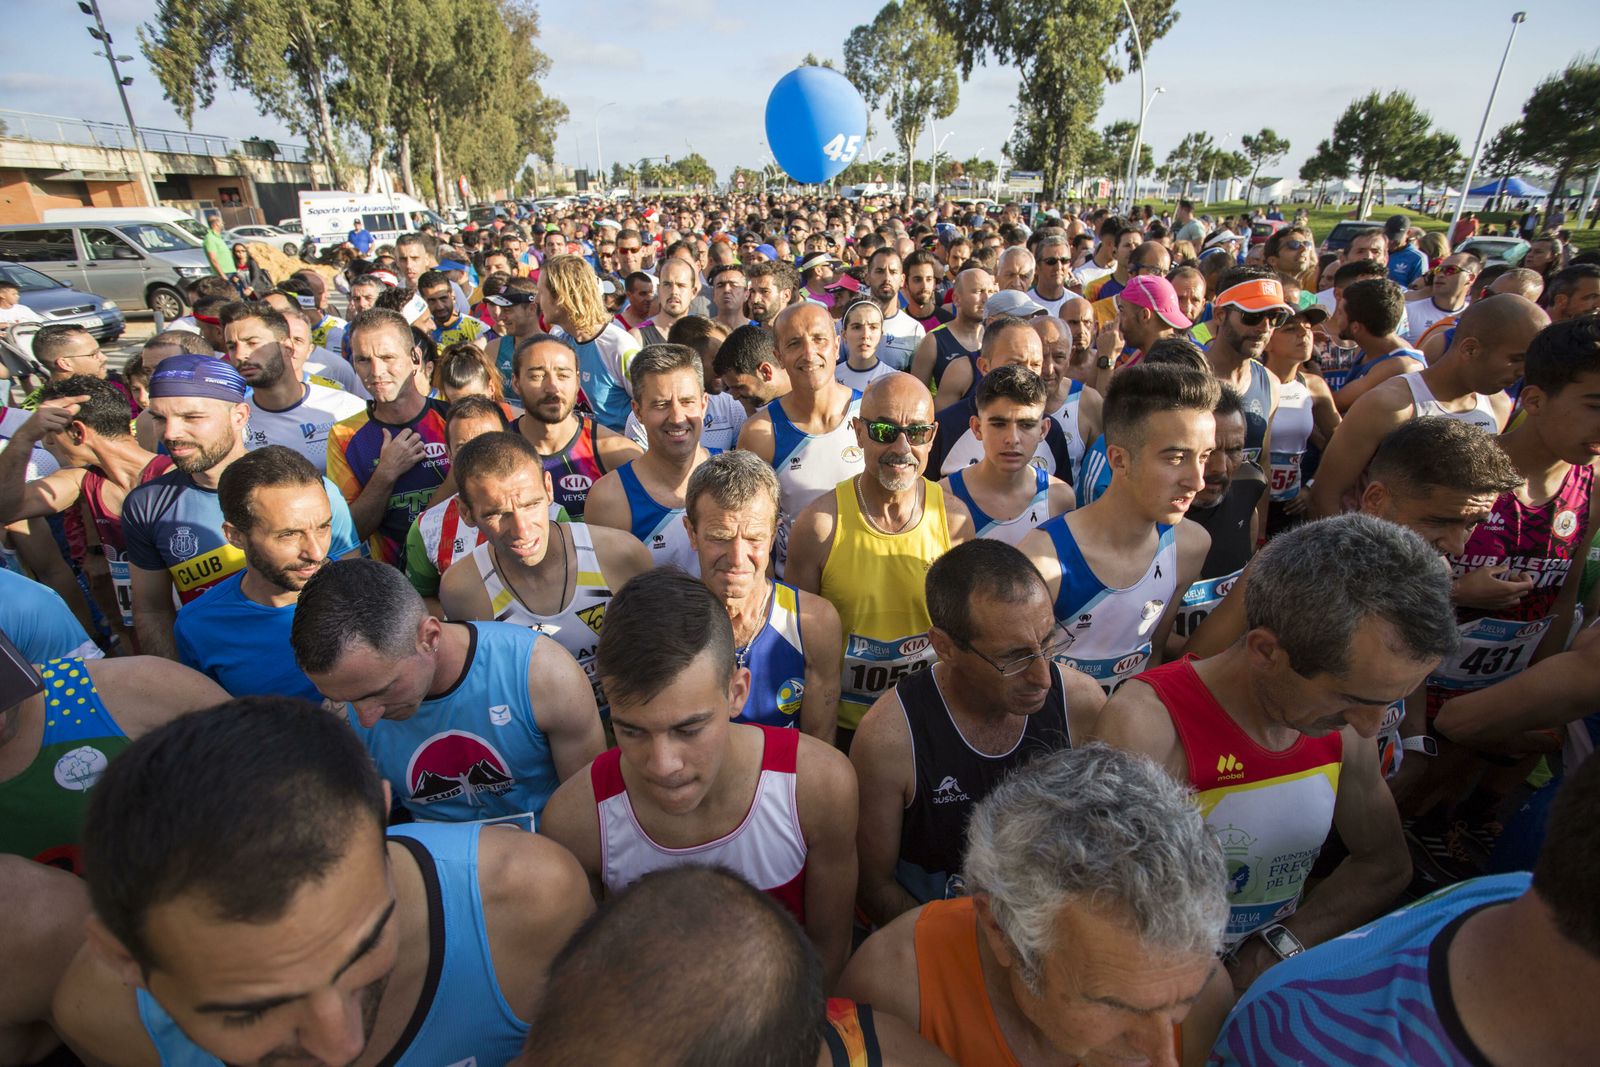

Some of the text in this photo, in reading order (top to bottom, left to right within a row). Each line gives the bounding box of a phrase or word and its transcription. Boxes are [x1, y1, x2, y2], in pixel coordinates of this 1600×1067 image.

[823, 133, 861, 162] 45
[307, 207, 340, 216] Soporte
[565, 478, 588, 488] KIA
[177, 556, 223, 585] CLUB
[868, 645, 890, 655] HUELVA
[903, 639, 926, 654] KIA
[1117, 656, 1140, 672] KIA
[1459, 643, 1525, 675] 431
[1217, 772, 1244, 781] mobel
[425, 787, 461, 801] CLUB
[1265, 878, 1284, 890] DE
[1230, 912, 1260, 923] UELVA
